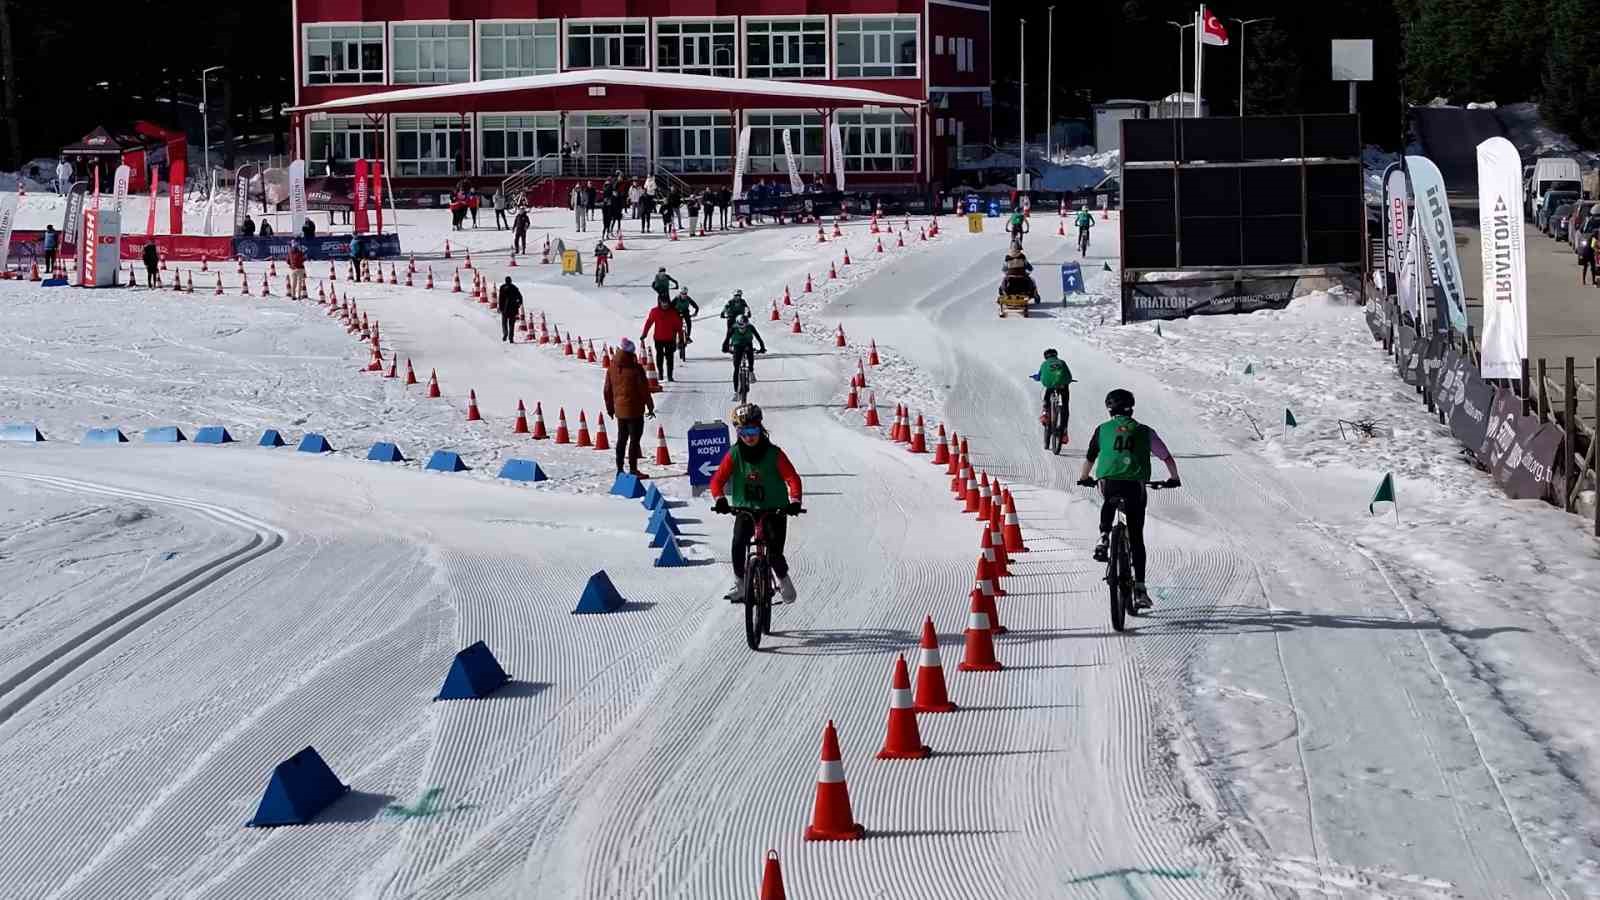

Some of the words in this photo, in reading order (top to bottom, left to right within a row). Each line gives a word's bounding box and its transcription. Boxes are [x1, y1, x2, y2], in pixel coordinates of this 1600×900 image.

[85, 213, 95, 280] FINISH
[690, 437, 726, 447] KAYAKLI
[1113, 435, 1136, 454] 44
[697, 446, 721, 456] KOŞU
